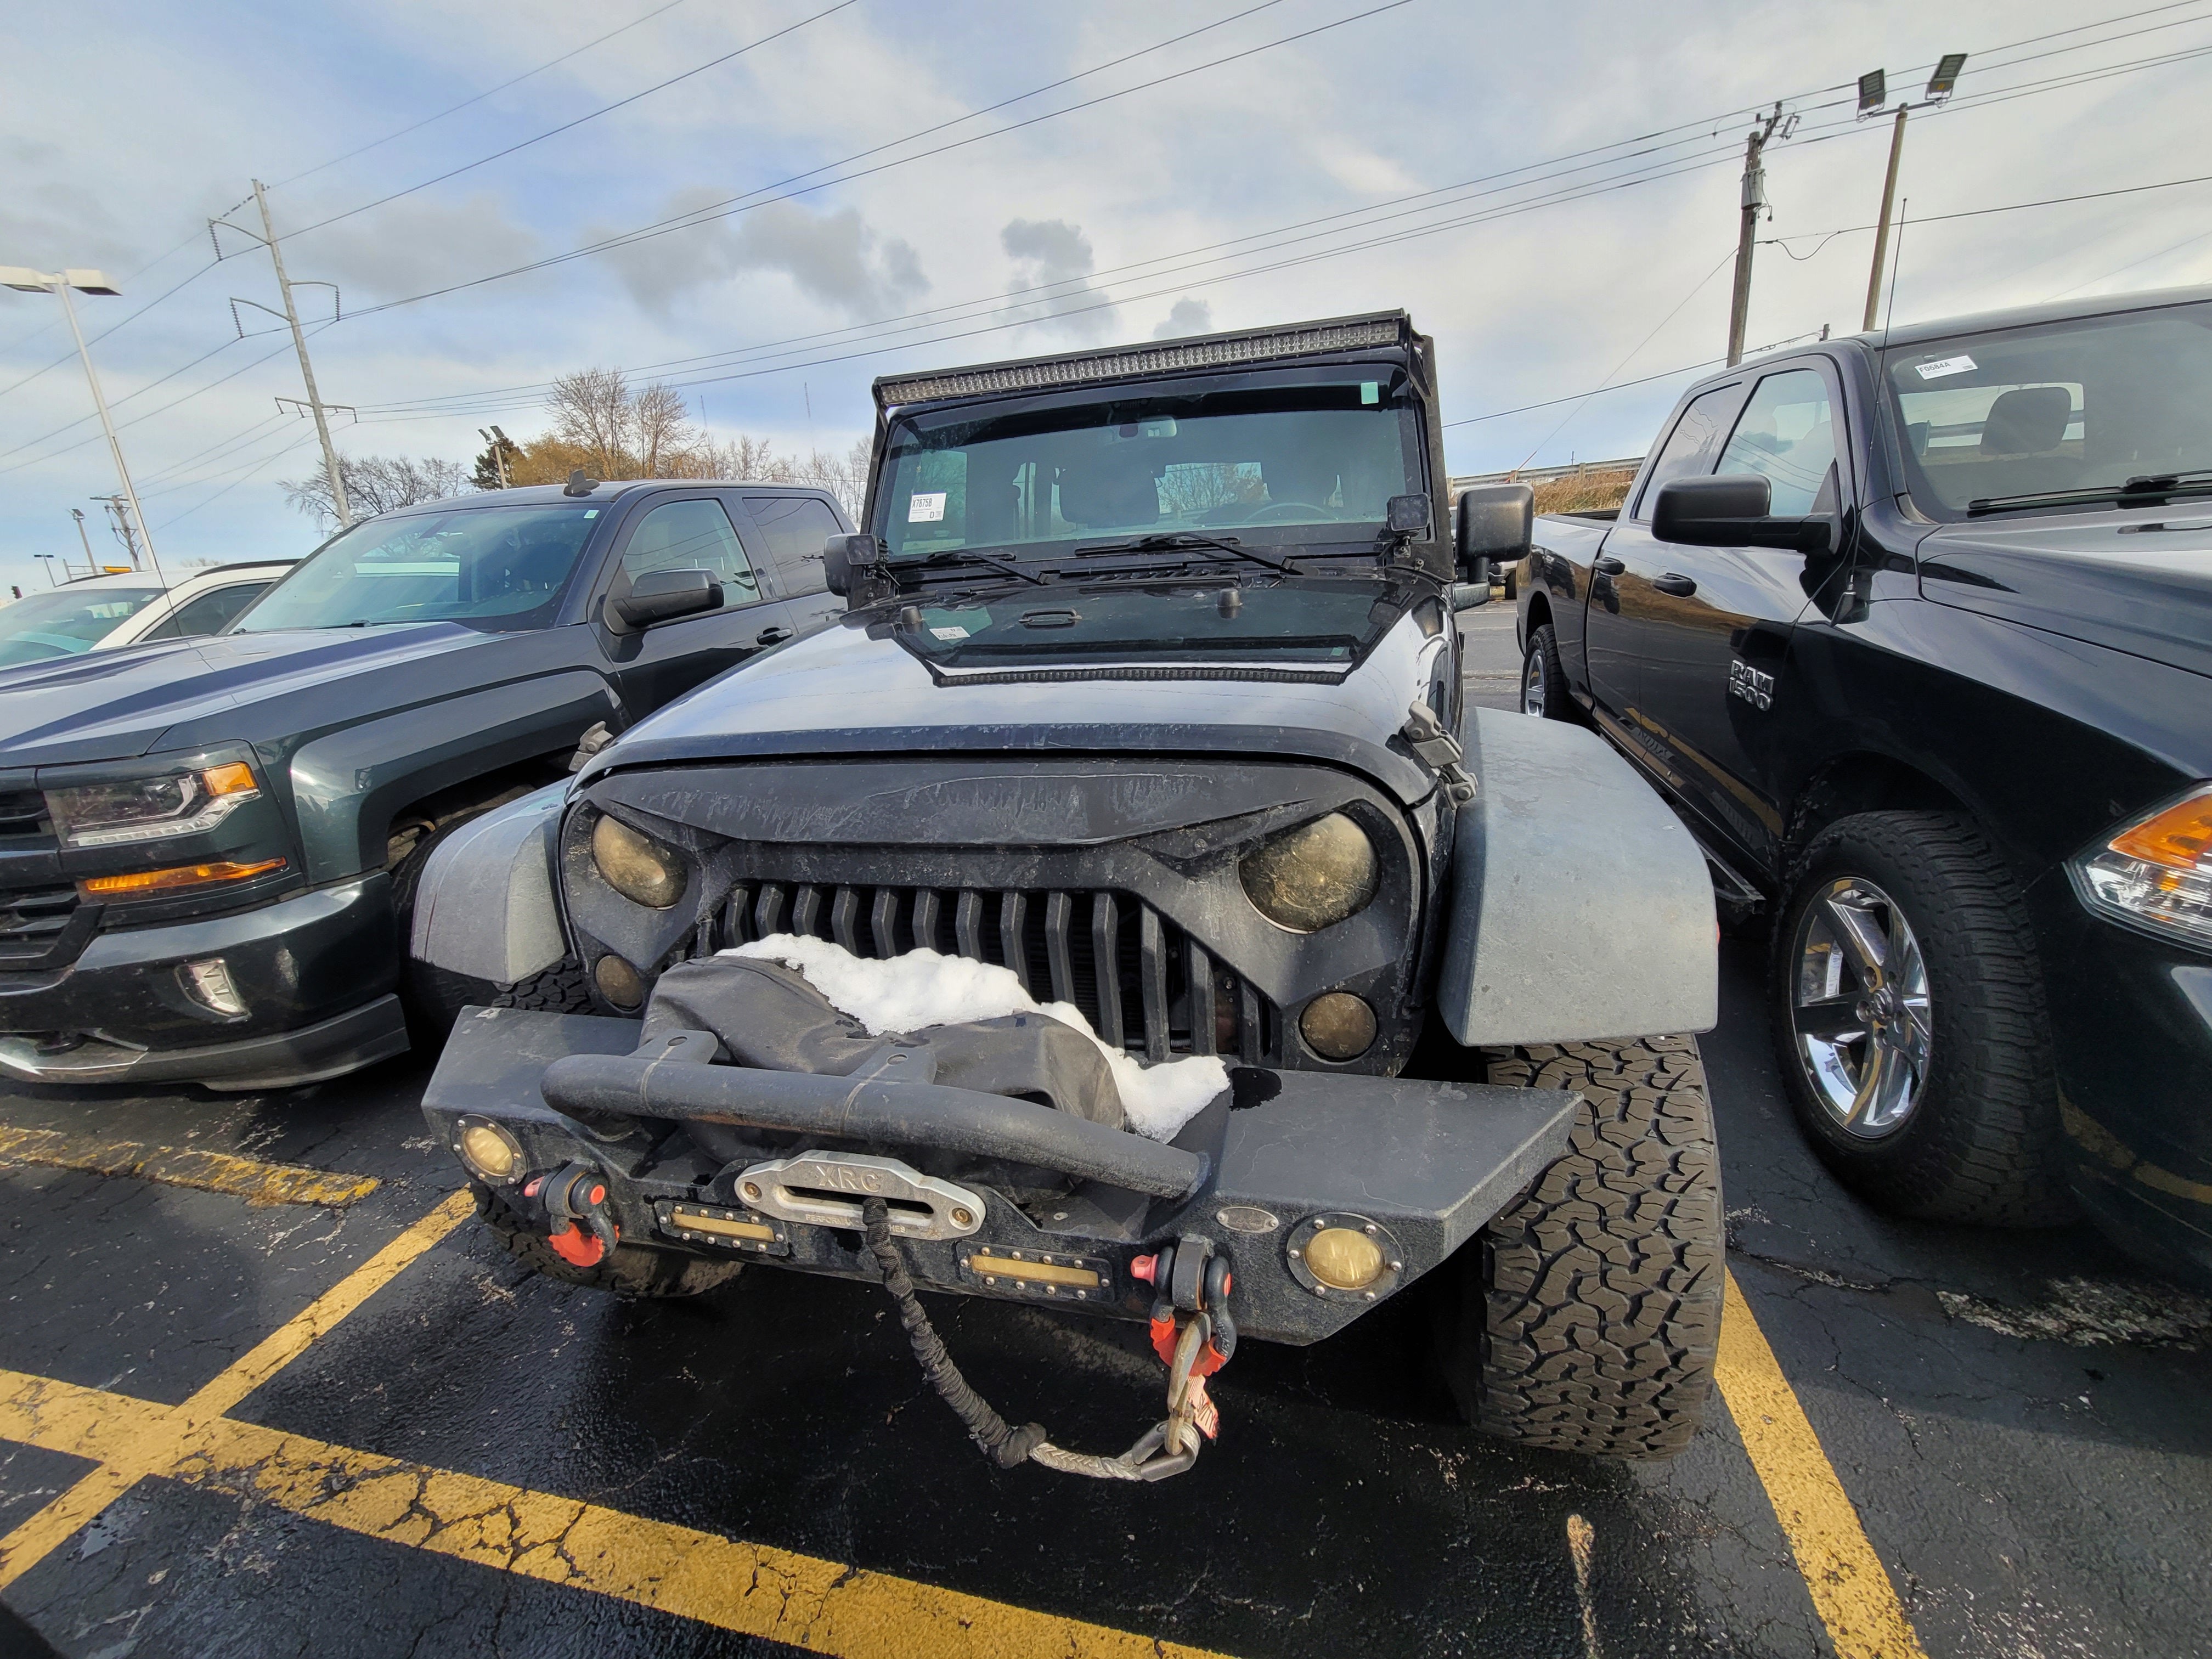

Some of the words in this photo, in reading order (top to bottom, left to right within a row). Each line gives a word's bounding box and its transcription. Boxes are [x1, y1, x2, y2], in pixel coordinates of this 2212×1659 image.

[1919, 362, 1951, 373] F0684A
[912, 498, 933, 508] X7875B
[1731, 659, 1775, 694] RAM
[1729, 676, 1771, 712] 1500
[816, 1165, 881, 1192] XRC
